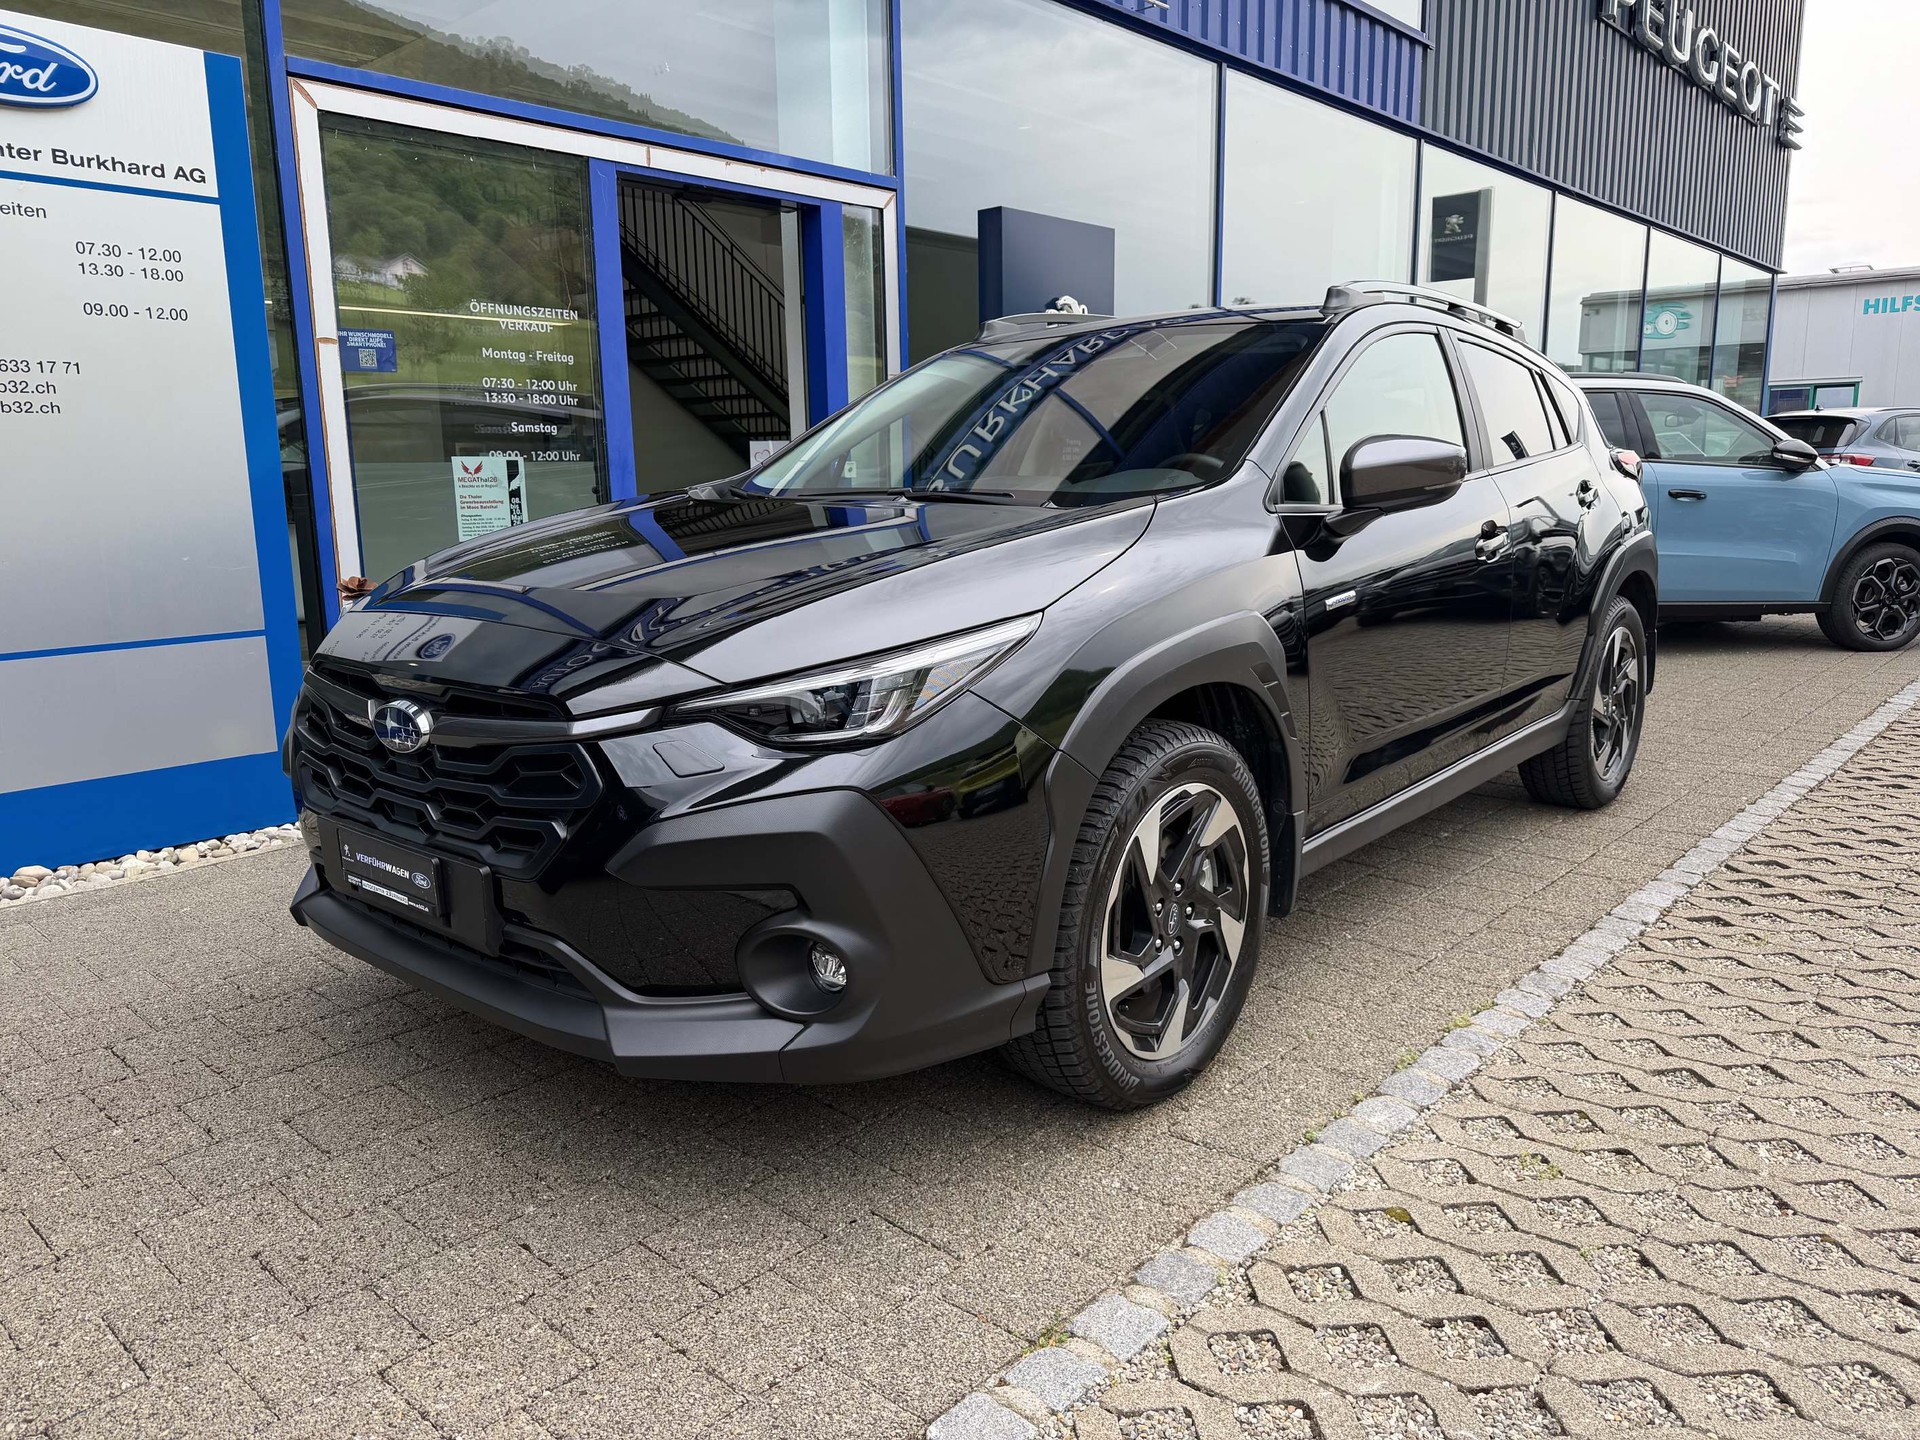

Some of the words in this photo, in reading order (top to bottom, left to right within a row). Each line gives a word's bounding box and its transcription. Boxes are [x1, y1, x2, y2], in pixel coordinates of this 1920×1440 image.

[0, 43, 58, 92] rd
[51, 148, 166, 179] Burkhard
[174, 166, 207, 184] AG
[0, 202, 47, 218] eiten
[75, 241, 122, 258] 07.30
[138, 248, 182, 263] 12.00
[78, 262, 124, 278] 13.30
[141, 268, 184, 282] 18.00
[83, 302, 129, 318] 09.00
[145, 307, 189, 321] 12.00
[470, 299, 578, 320] ÖFFNUNGSZEITEN
[500, 320, 553, 333] VERKAUF
[482, 347, 526, 362] Montag
[536, 351, 574, 365] Freitag
[36, 360, 56, 373] 17
[63, 361, 81, 375] 71
[482, 377, 515, 389] 07:30
[526, 379, 555, 390] 12:00
[558, 381, 578, 391] Uhr
[484, 392, 516, 404] 13:30
[527, 394, 557, 405] 18:00
[559, 395, 578, 406] Uhr
[511, 422, 558, 435] Samstag
[531, 451, 560, 461] 12:00
[562, 451, 581, 461] Uhr
[1231, 762, 1270, 873] BRIDGESTONE
[355, 852, 410, 880] VERFÜHRWAGEN
[1085, 981, 1140, 1095] BRIDGESTONE
